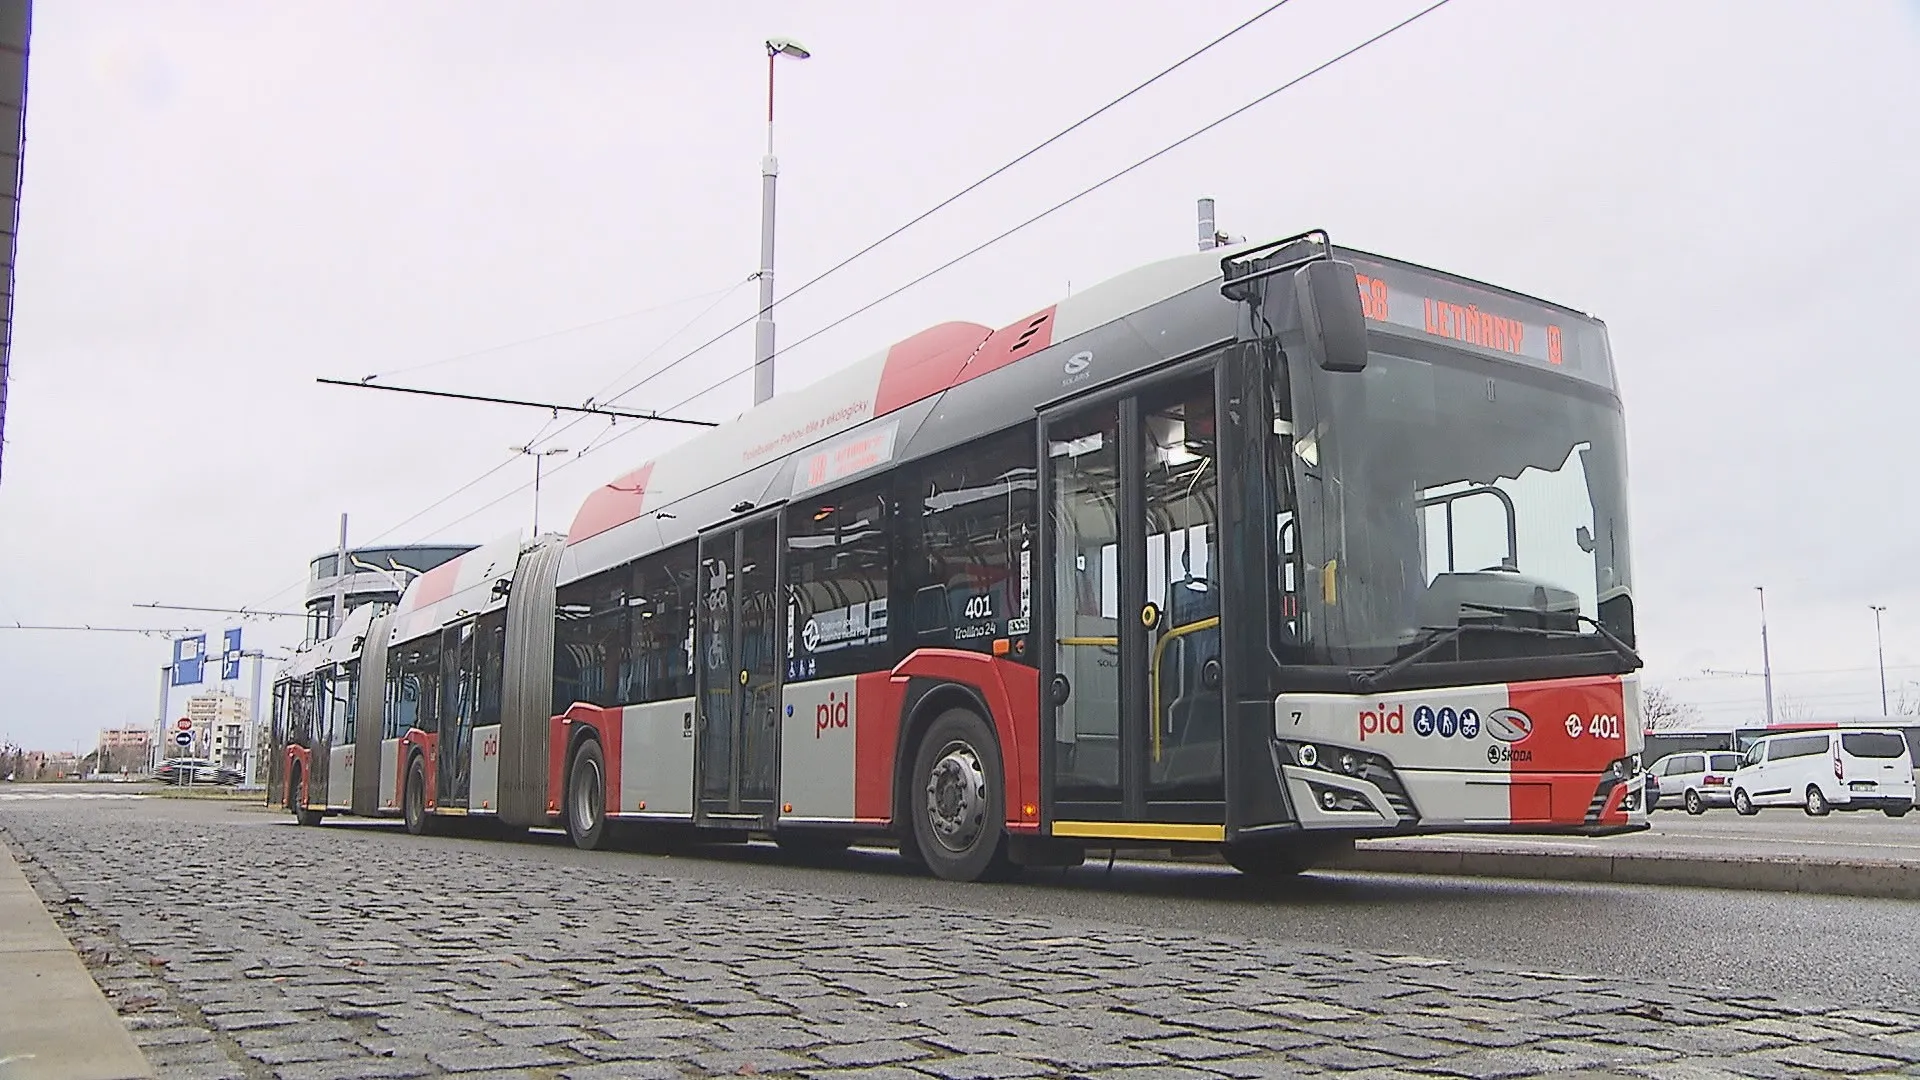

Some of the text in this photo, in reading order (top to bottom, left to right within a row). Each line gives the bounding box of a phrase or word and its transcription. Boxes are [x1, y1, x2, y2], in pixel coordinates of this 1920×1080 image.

[965, 595, 992, 619] 401
[954, 624, 984, 640] Trollino
[985, 622, 996, 636] 24
[817, 691, 848, 739] pid
[1291, 712, 1301, 725] 7
[1359, 702, 1404, 741] pid
[1588, 714, 1620, 738] 401
[484, 733, 498, 762] pid
[1501, 747, 1532, 762] ŠKODA
